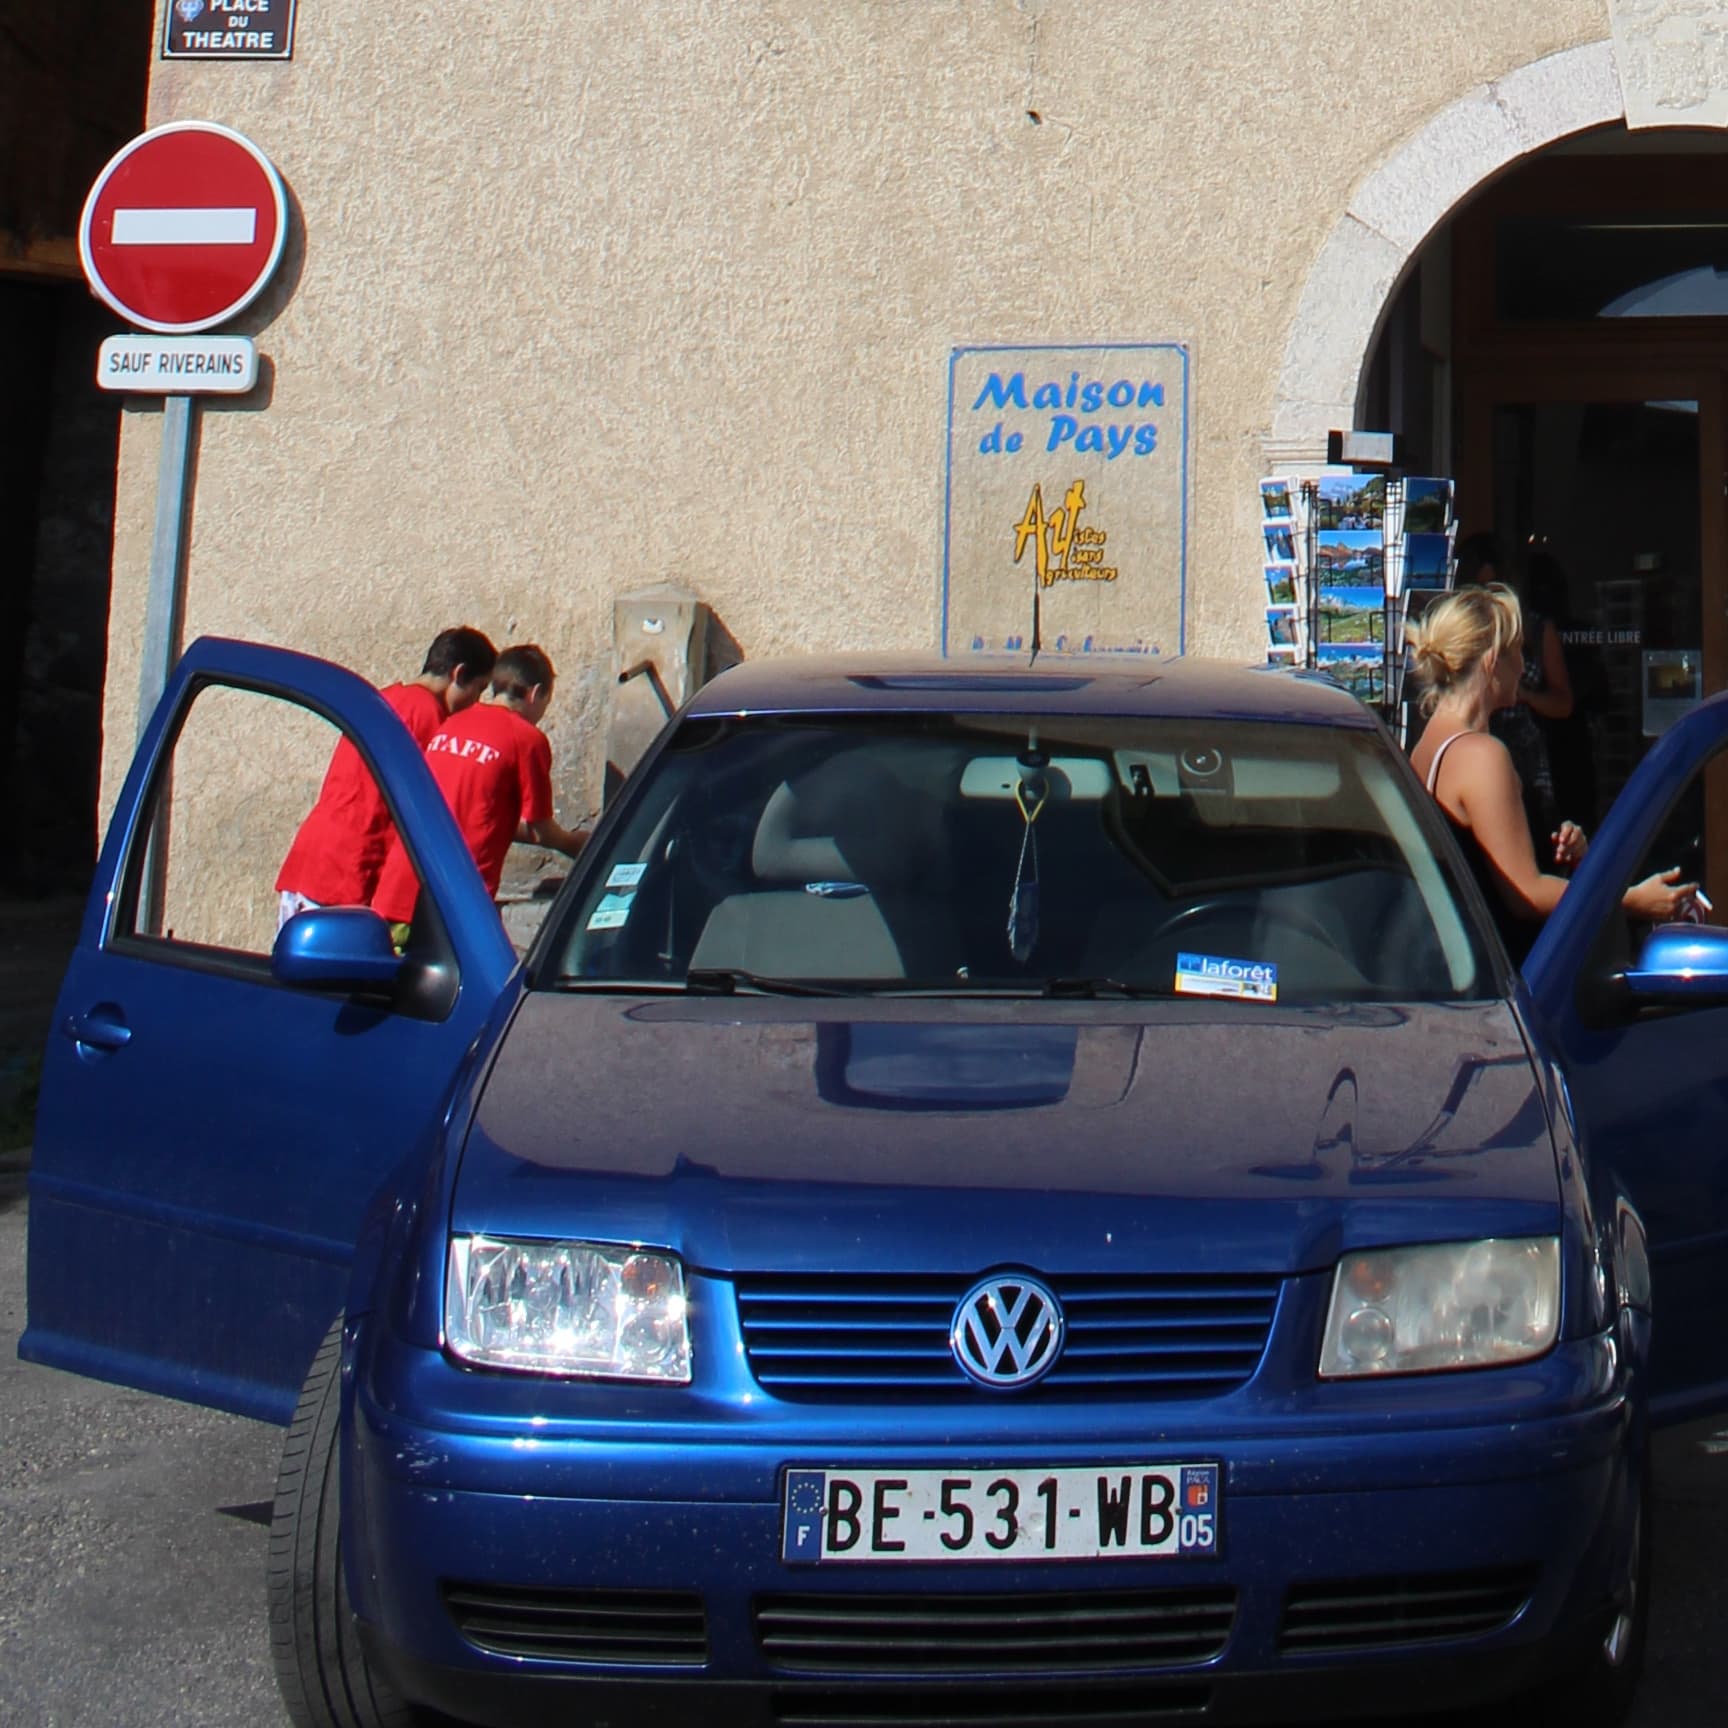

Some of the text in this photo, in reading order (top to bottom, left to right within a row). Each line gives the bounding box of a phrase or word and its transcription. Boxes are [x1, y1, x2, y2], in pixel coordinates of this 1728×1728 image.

[228, 15, 249, 29] DU
[182, 31, 274, 49] THEATRE
[109, 351, 244, 375] SAUF RIVERAINS
[972, 370, 1165, 413] Maison
[979, 414, 1158, 460] de Pays
[1561, 627, 1641, 644] NTRÉE LIBRE
[427, 734, 501, 764] TAFF
[1202, 957, 1273, 980] laforêt
[796, 1526, 811, 1546] F
[1181, 1513, 1213, 1547] 05
